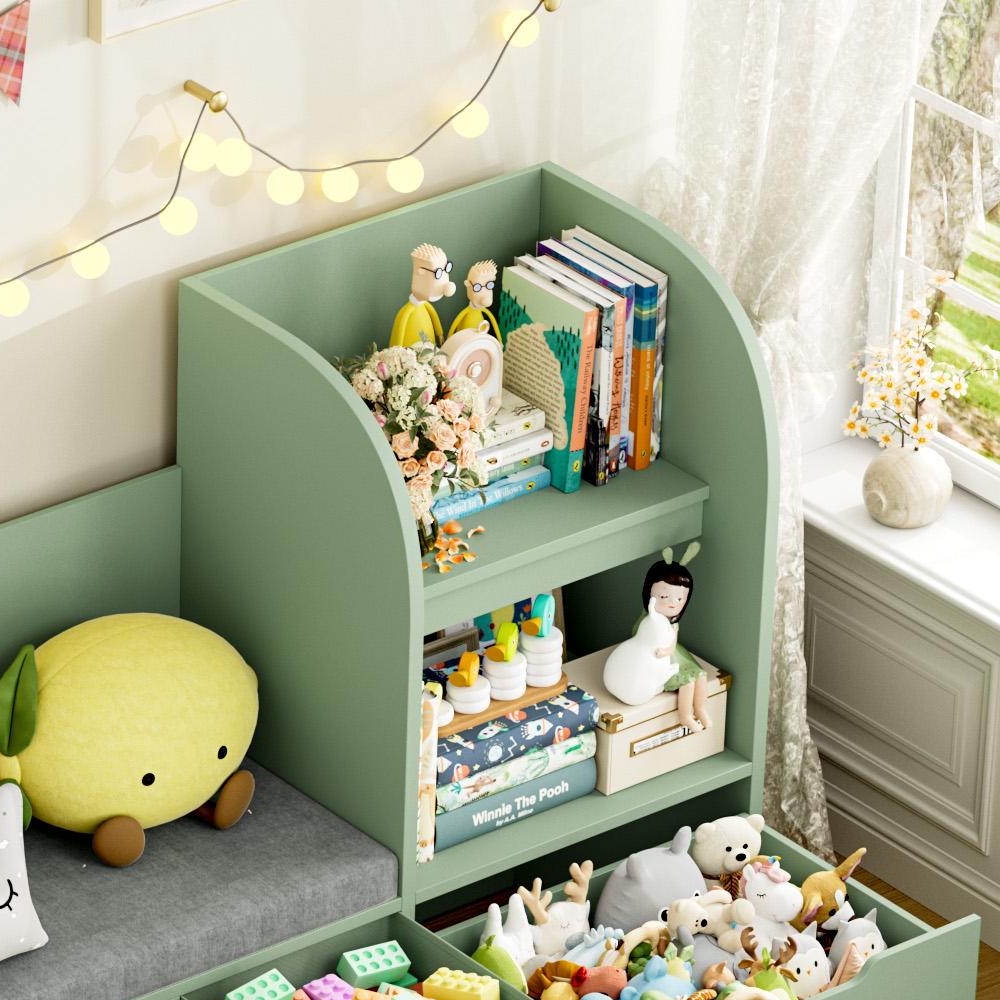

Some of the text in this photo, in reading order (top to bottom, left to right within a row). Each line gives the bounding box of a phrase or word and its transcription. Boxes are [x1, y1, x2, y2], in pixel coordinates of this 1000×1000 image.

[580, 361, 592, 395] Railway
[577, 396, 588, 433] Children
[471, 803, 513, 827] Winnie
[514, 794, 537, 811] The
[539, 781, 569, 802] Pooh
